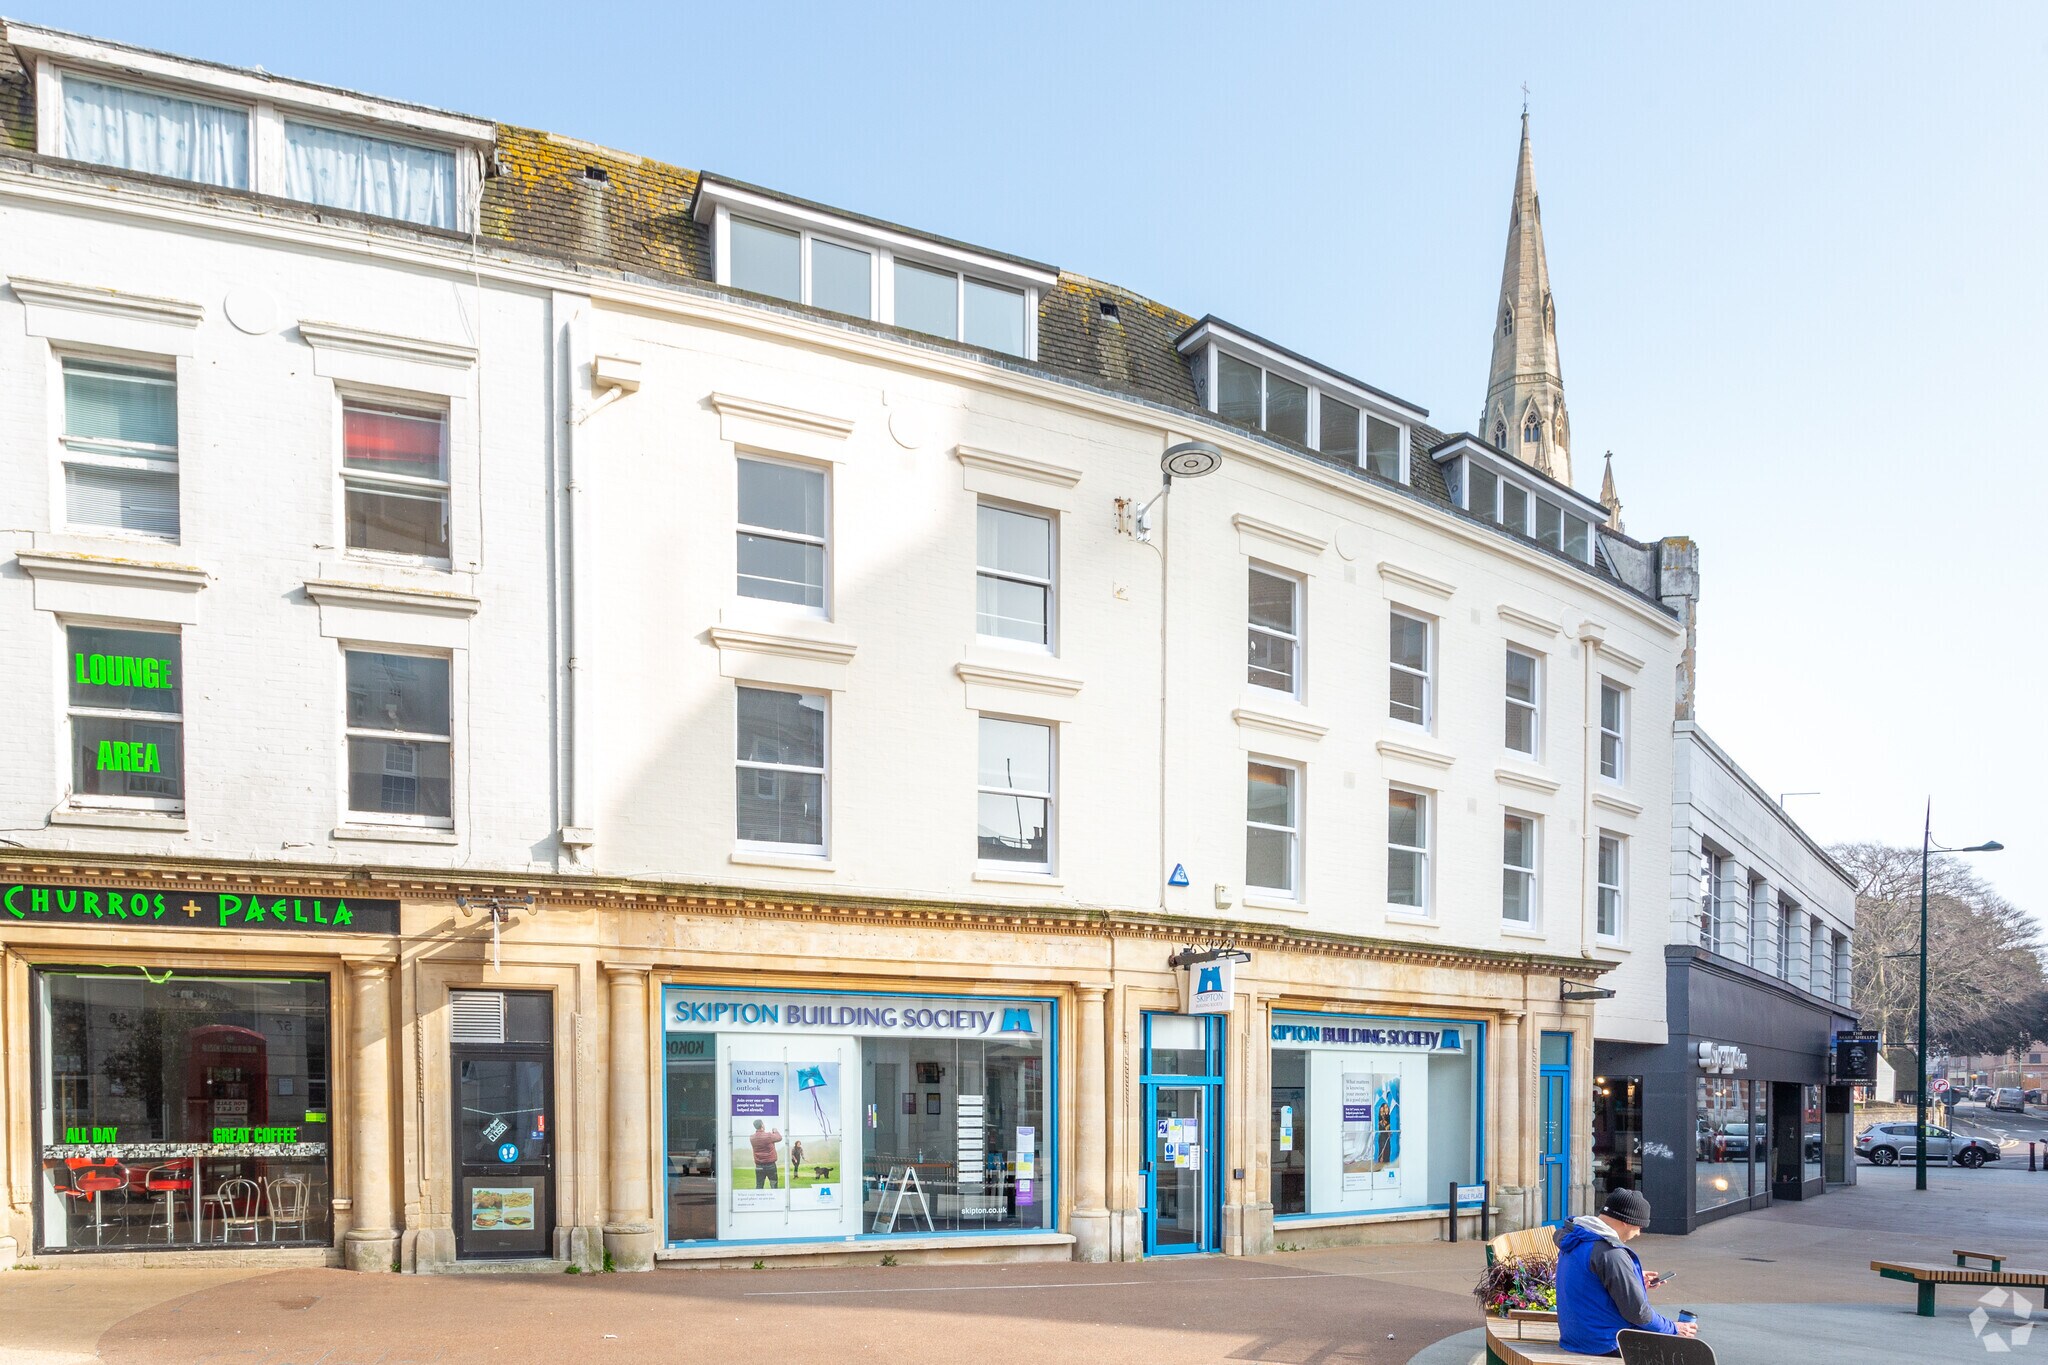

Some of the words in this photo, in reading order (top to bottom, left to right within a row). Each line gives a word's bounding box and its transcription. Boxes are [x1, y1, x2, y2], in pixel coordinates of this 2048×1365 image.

[76, 653, 172, 689] LOUNGE
[96, 740, 160, 773] AREA
[4, 885, 166, 919] CHURROS
[182, 899, 202, 918] +
[219, 894, 354, 927] PAELLA
[1196, 993, 1224, 1002] SKIPTON
[676, 1001, 779, 1024] SKIPTON
[787, 1004, 898, 1028] BUILDING
[904, 1008, 994, 1033] SOCIETY
[1272, 1024, 1320, 1041] KIPTON
[1322, 1027, 1386, 1045] BUILDING
[1388, 1030, 1440, 1050] SOCIETY
[66, 1127, 89, 1144] ALL
[92, 1127, 118, 1144] DAY
[212, 1127, 250, 1143] GREAT
[254, 1127, 297, 1143] COFFEE
[961, 1206, 1007, 1215] skipton.co.uk
